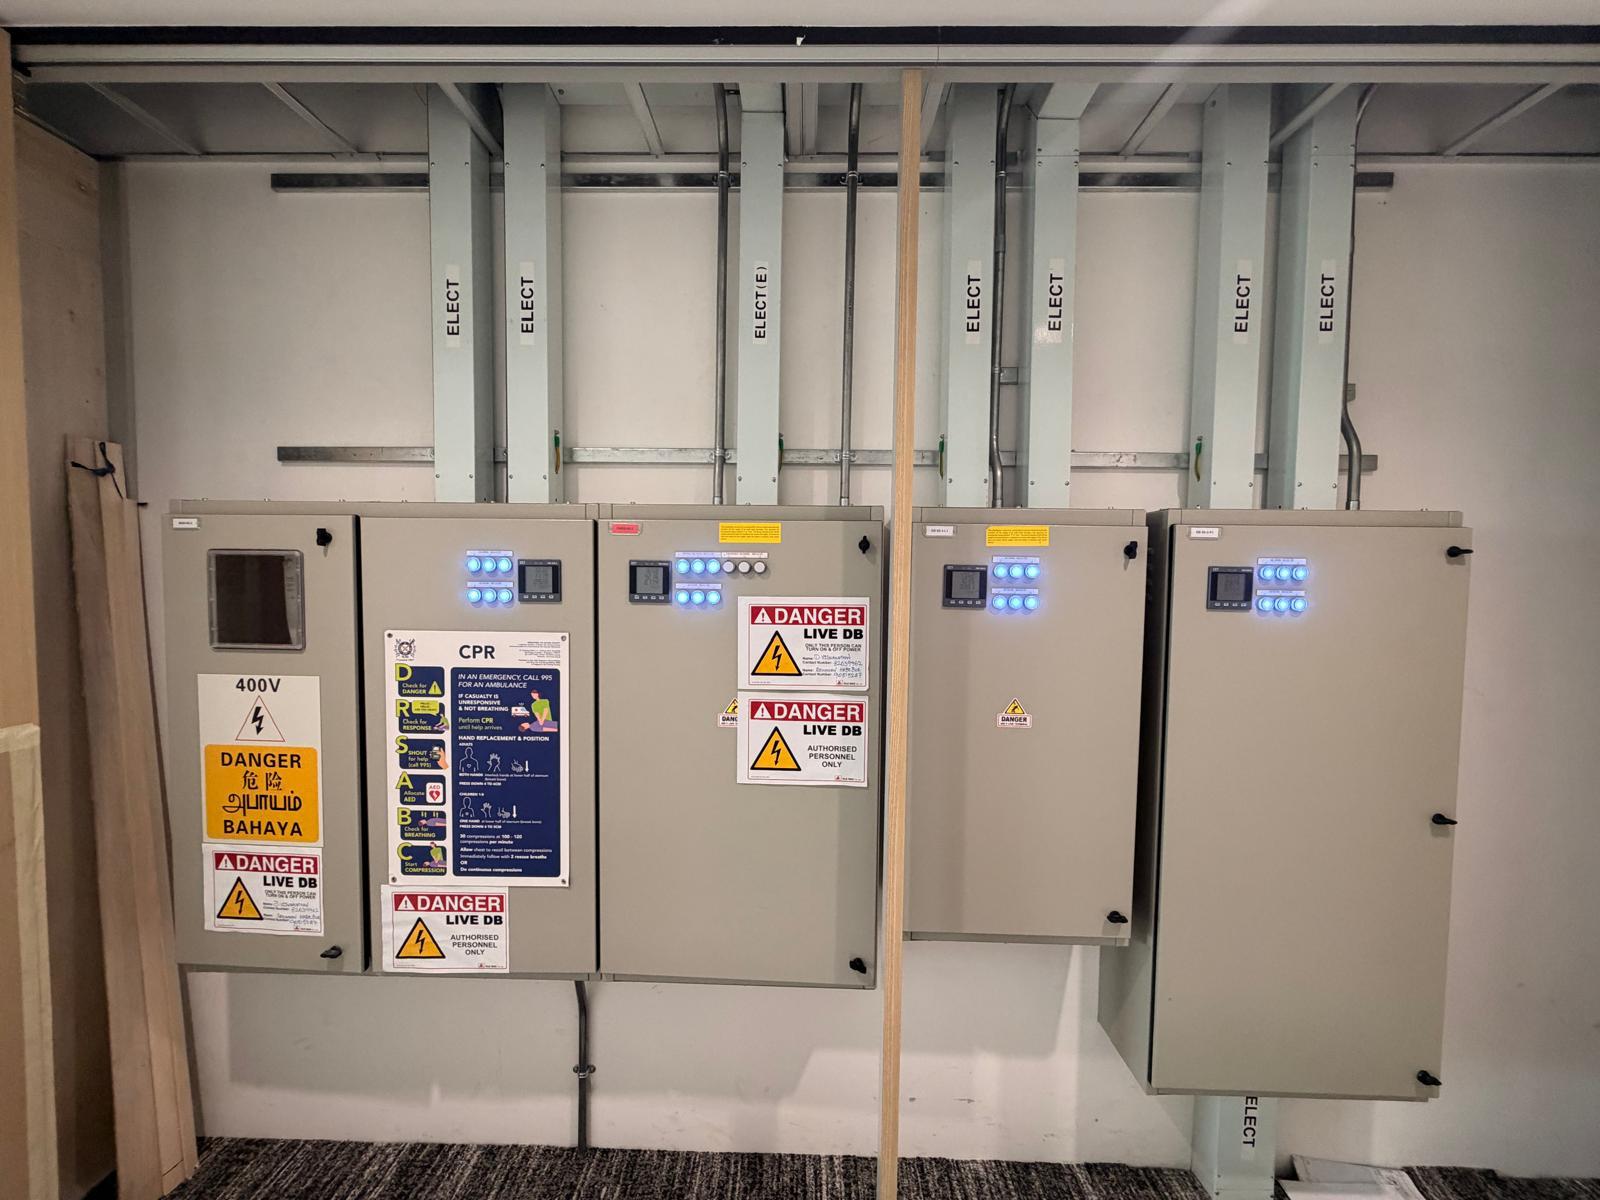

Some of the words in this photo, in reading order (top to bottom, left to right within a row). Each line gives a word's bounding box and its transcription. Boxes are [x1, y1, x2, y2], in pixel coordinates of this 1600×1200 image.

[446, 278, 460, 336] ELECT
[521, 276, 534, 334] ELECT
[966, 274, 981, 333] ELECT
[1048, 273, 1063, 332] ELECT
[1234, 274, 1251, 333] ELECT
[1319, 273, 1335, 333] ELECT
[775, 608, 861, 624] DANGER
[803, 628, 838, 640] LIVE
[843, 628, 864, 640] DB
[458, 644, 496, 660] CPR
[479, 673, 522, 681] EMERGENCY,
[485, 681, 527, 689] AMBULANCE
[235, 678, 281, 693] 400V
[774, 703, 861, 721] DANGER
[803, 725, 836, 735] LIVE
[841, 725, 862, 736] DB
[221, 752, 302, 769] DANGER
[821, 760, 842, 768] ONLY
[223, 819, 303, 837] BAHAYA
[236, 855, 315, 873] DANGER
[263, 875, 294, 887] LIVE
[298, 877, 318, 889] DB
[417, 896, 500, 911] DANGER
[446, 915, 479, 925] LIVE
[483, 915, 503, 925] DB
[1242, 1096, 1258, 1148] ELECT
